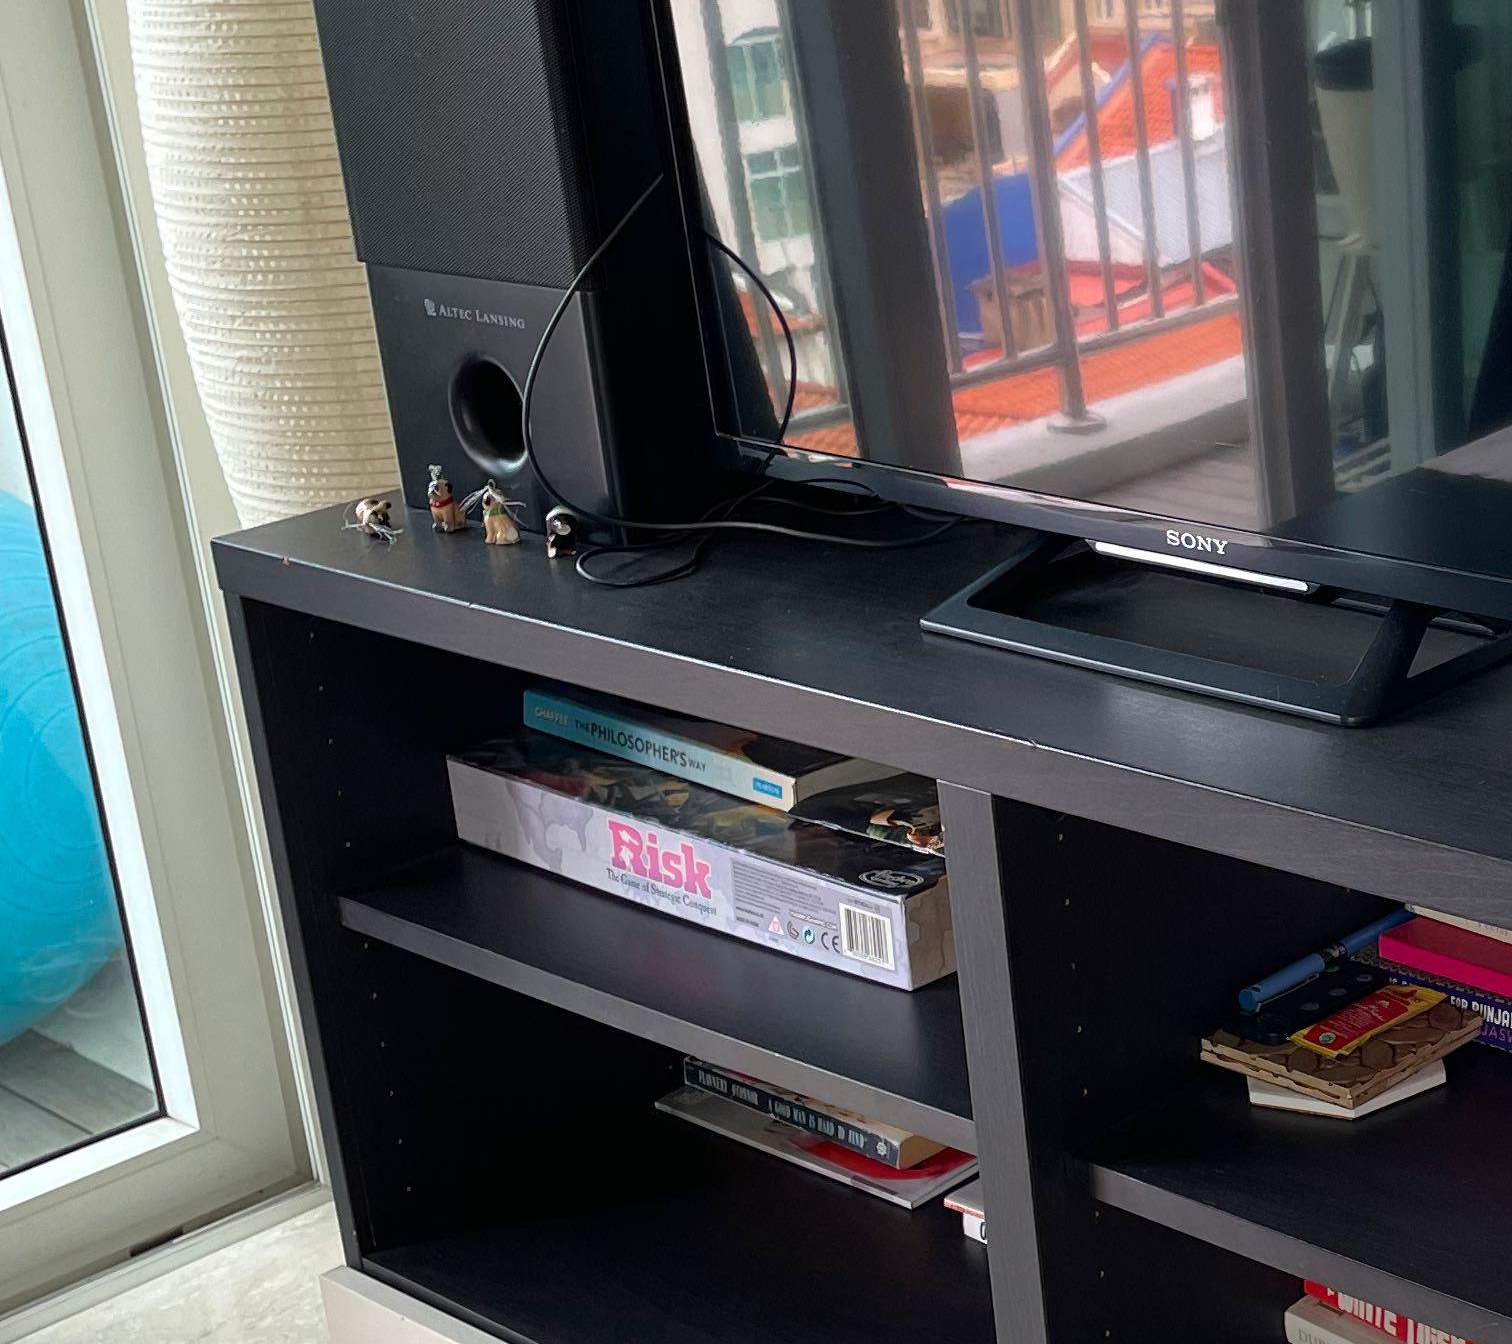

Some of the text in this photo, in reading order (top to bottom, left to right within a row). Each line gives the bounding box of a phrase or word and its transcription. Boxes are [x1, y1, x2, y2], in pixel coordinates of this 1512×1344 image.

[437, 304, 526, 330] ALTEC LANSING
[1166, 529, 1229, 555] SONY
[575, 719, 707, 774] THE PHILOSOPHER'S WAY
[607, 819, 713, 899] Risk
[605, 867, 620, 883] The
